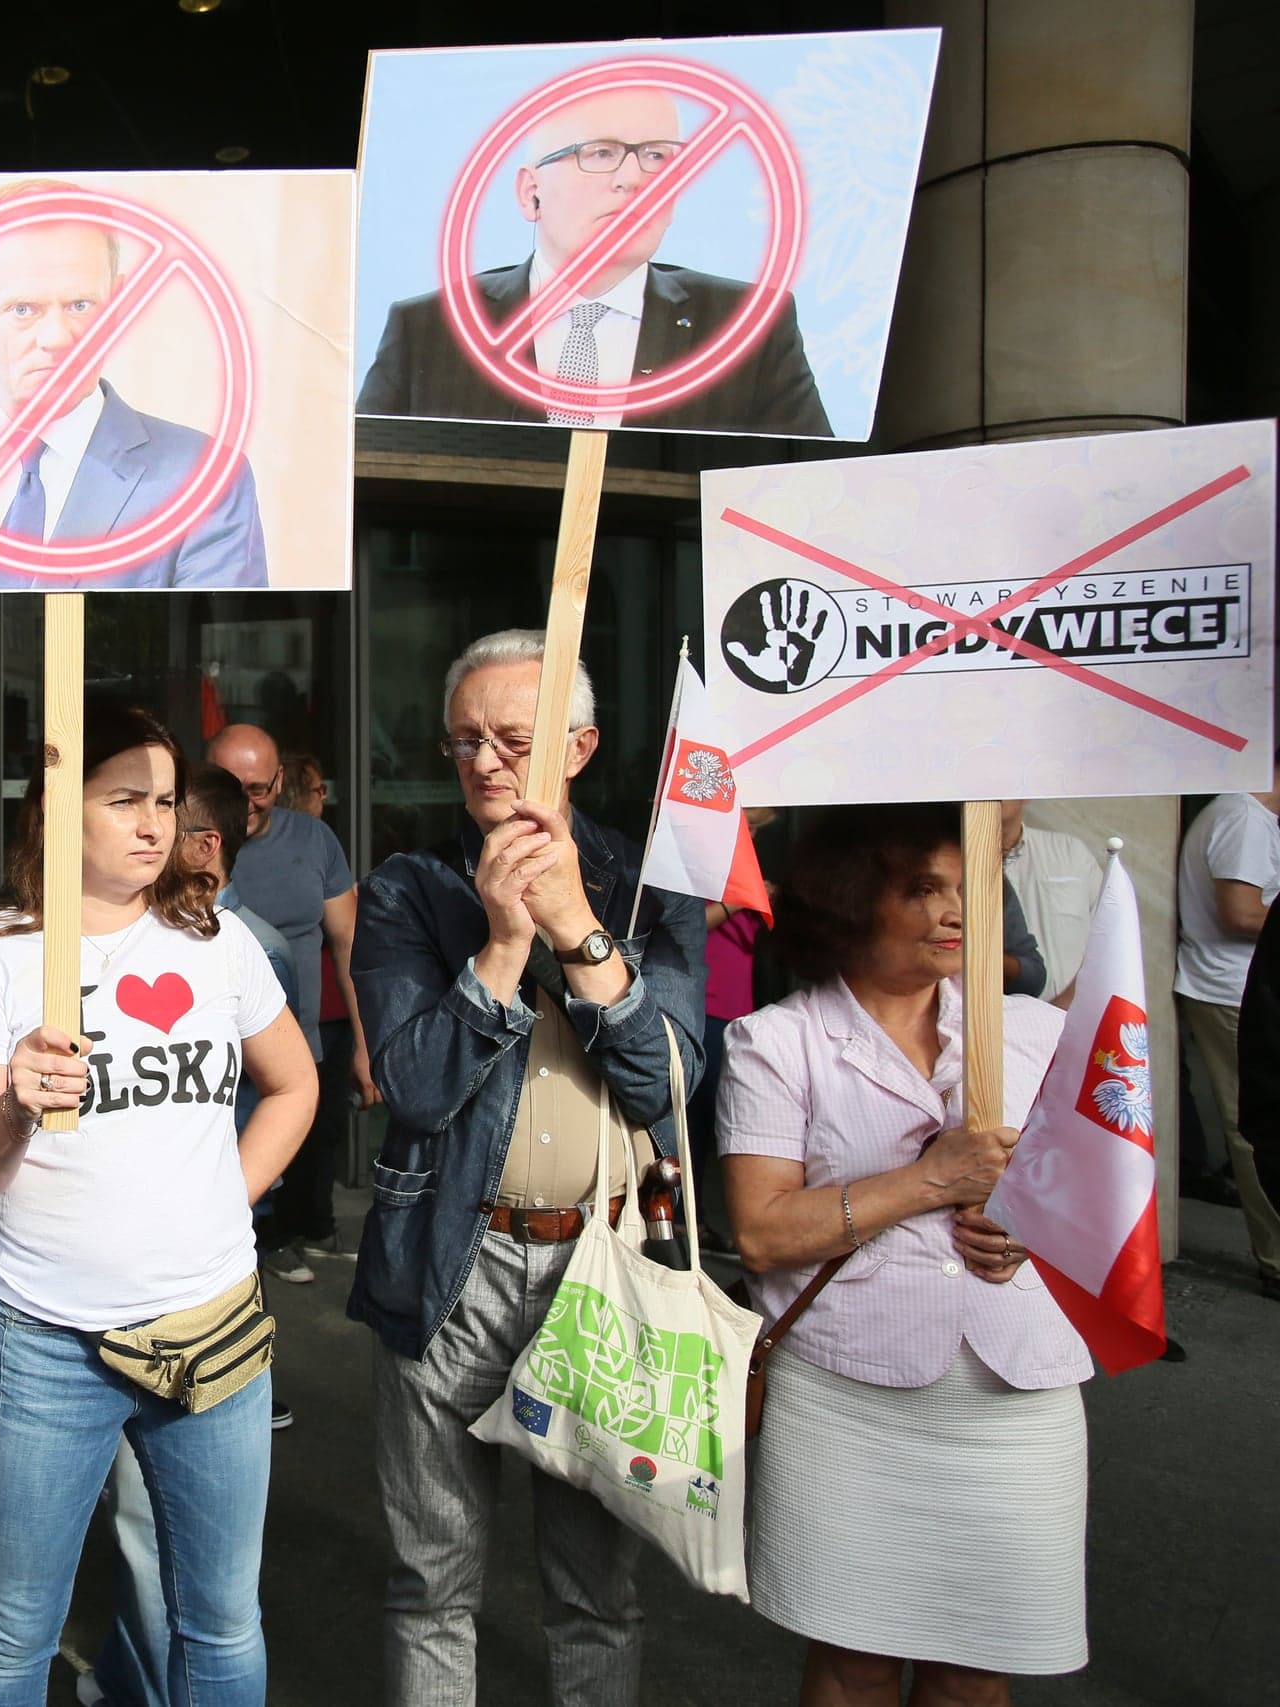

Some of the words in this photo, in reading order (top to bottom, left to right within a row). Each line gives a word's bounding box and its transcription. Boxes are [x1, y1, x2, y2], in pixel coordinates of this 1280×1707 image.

[855, 573, 1241, 613] STOWARZYSZENIE
[856, 615, 1025, 660] NIGDY
[1040, 602, 1240, 655] WIĘCEJ
[79, 1039, 237, 1117] LSKA
